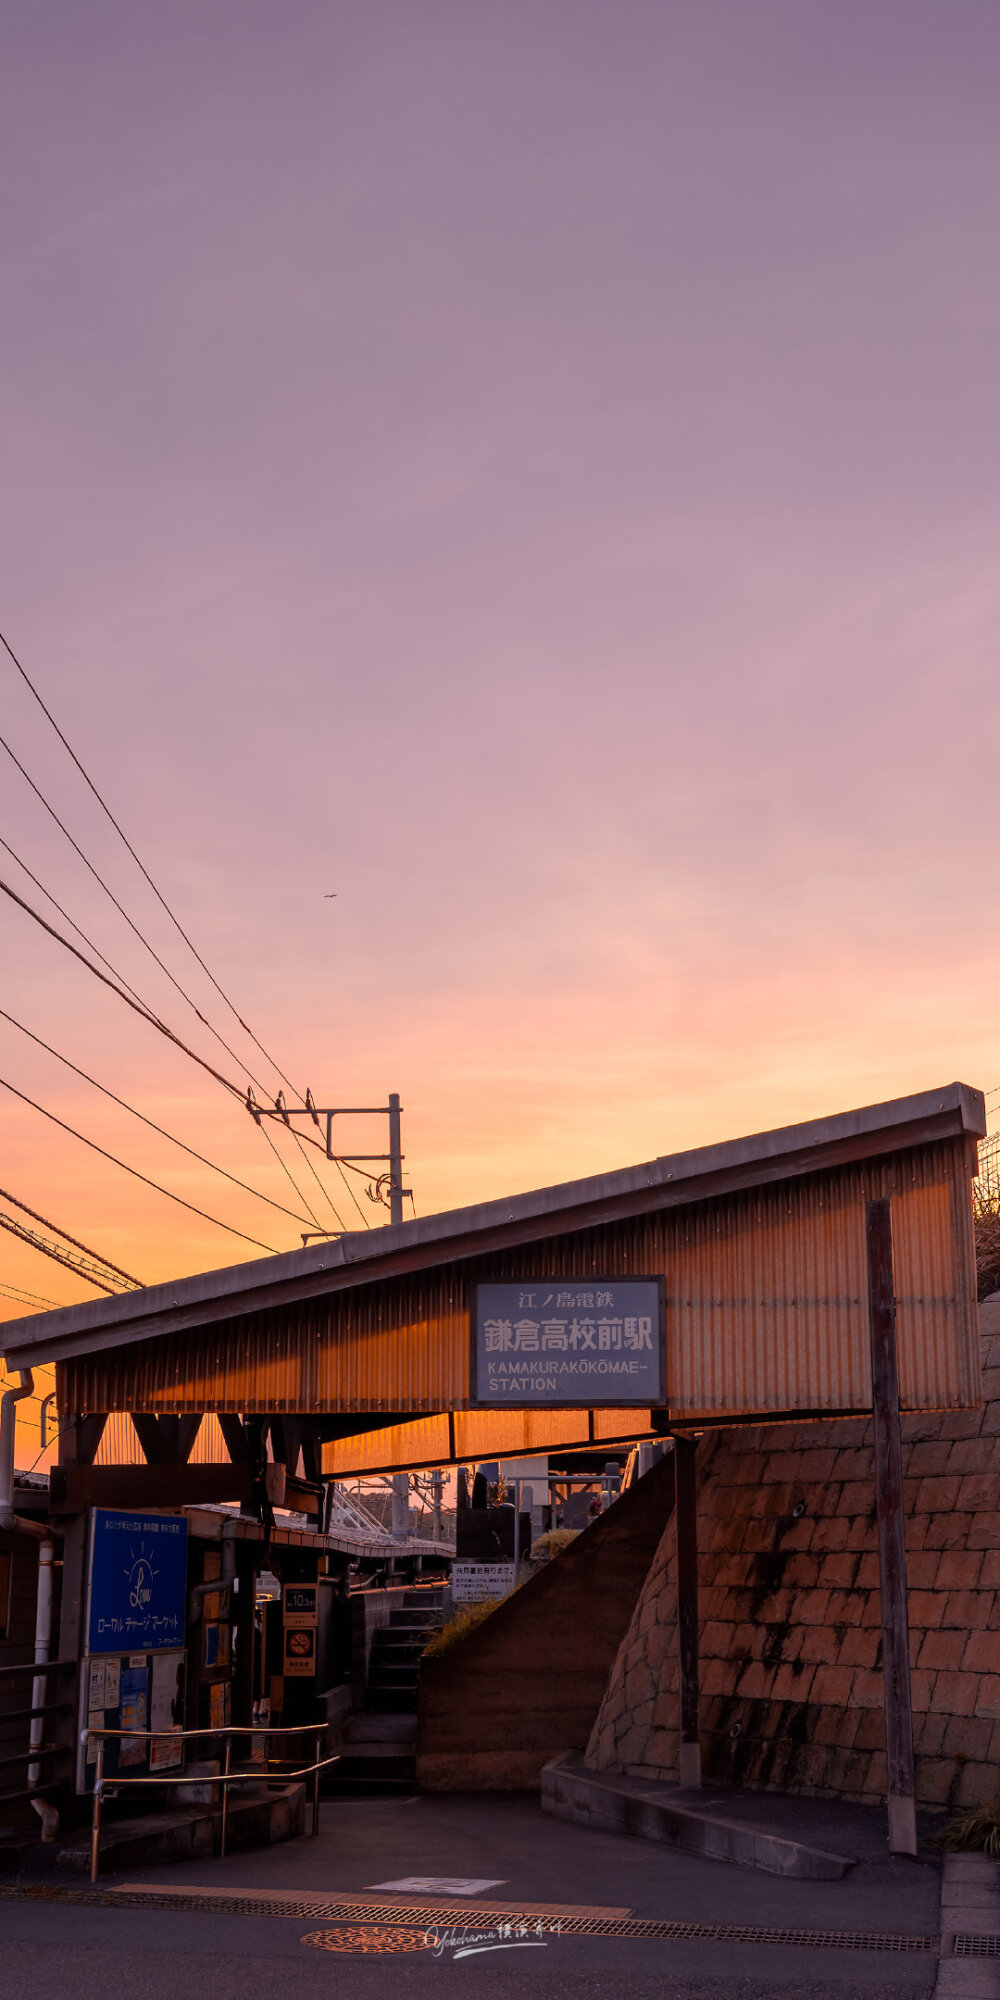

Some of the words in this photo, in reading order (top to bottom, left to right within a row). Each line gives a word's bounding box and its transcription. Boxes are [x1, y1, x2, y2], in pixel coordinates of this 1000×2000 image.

[518, 1291, 615, 1308] 江ノ島電鉄
[482, 1316, 654, 1352] 鎌倉高校前駅
[488, 1378, 557, 1391] STATION
